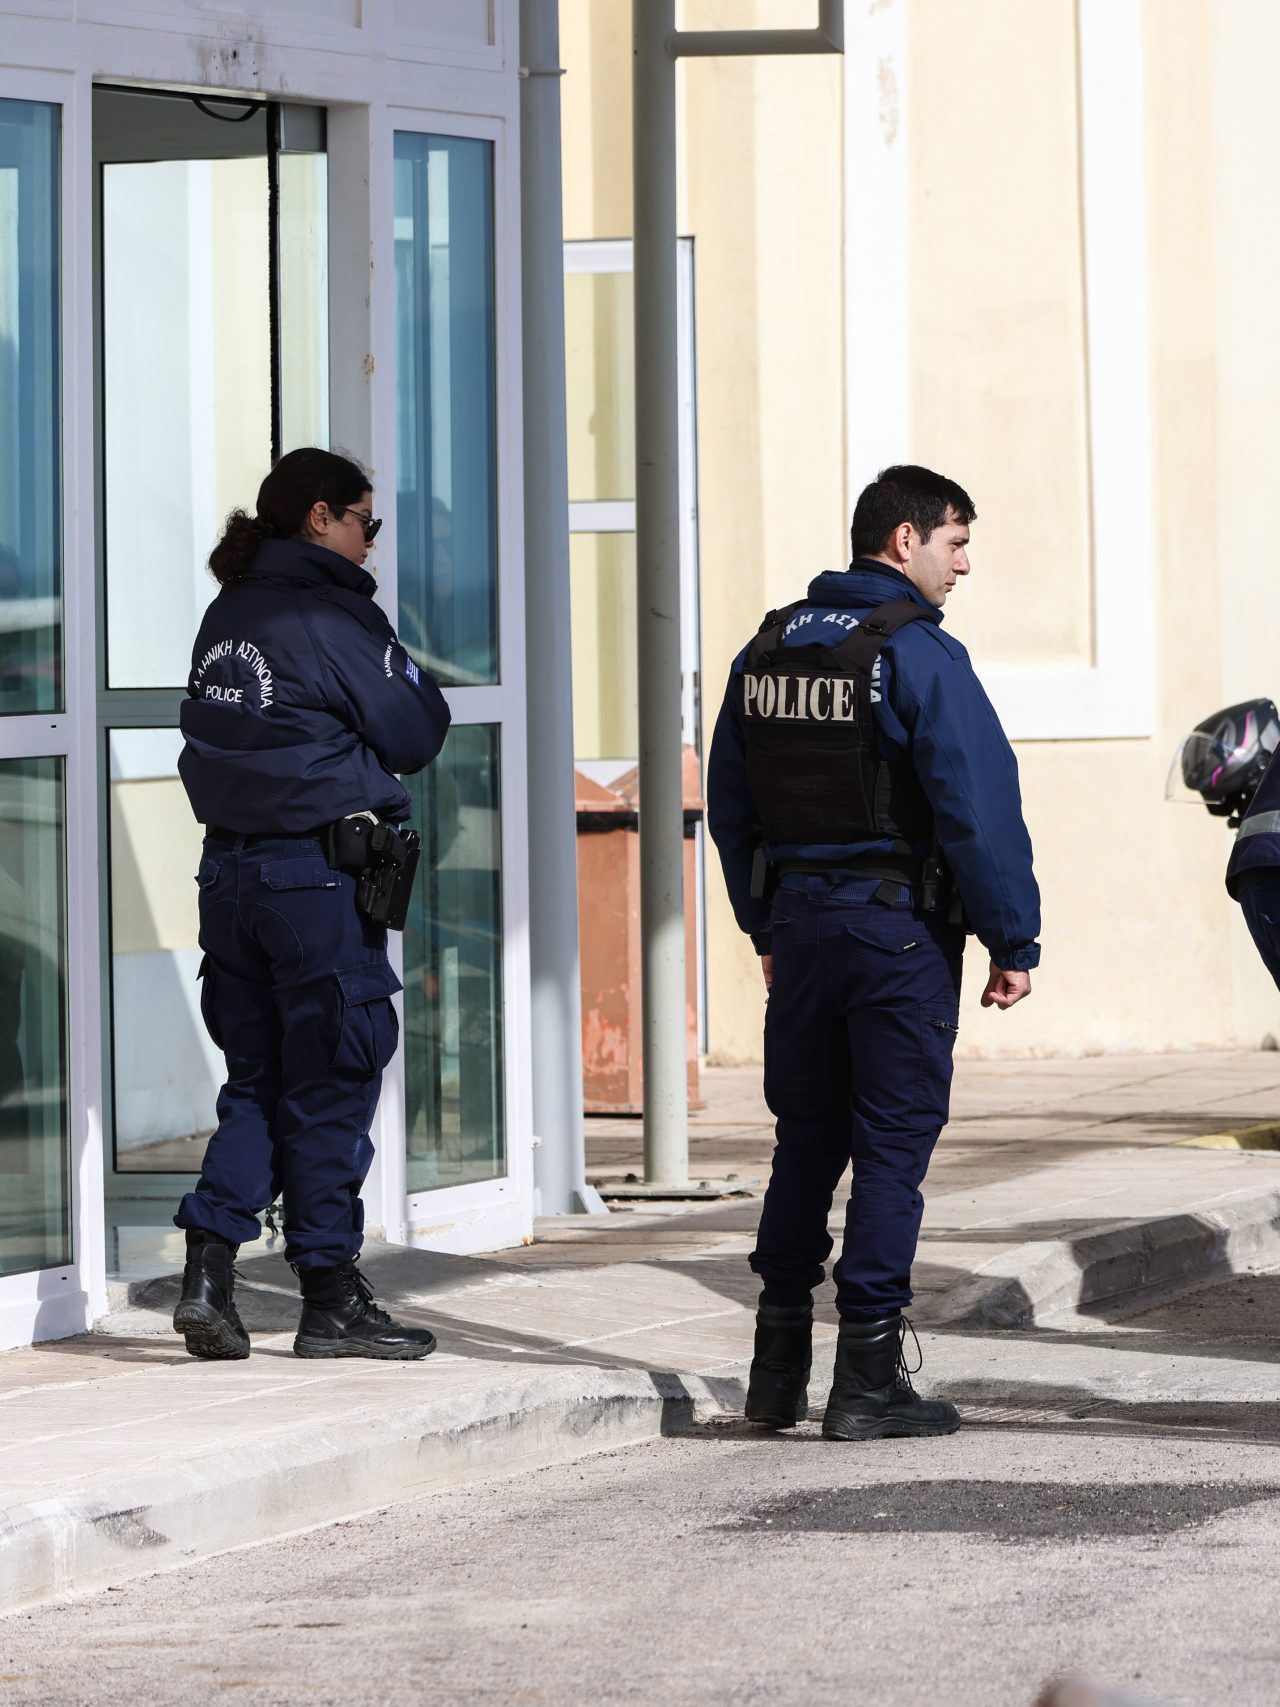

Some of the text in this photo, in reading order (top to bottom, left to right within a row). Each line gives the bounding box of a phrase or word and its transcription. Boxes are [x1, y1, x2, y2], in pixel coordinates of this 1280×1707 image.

[193, 639, 273, 708] ΛΛΗΝΙΚΗ ΑΣΤΥΝΟΜΙΑ
[205, 685, 244, 703] POLICE
[743, 673, 855, 722] POLICE
